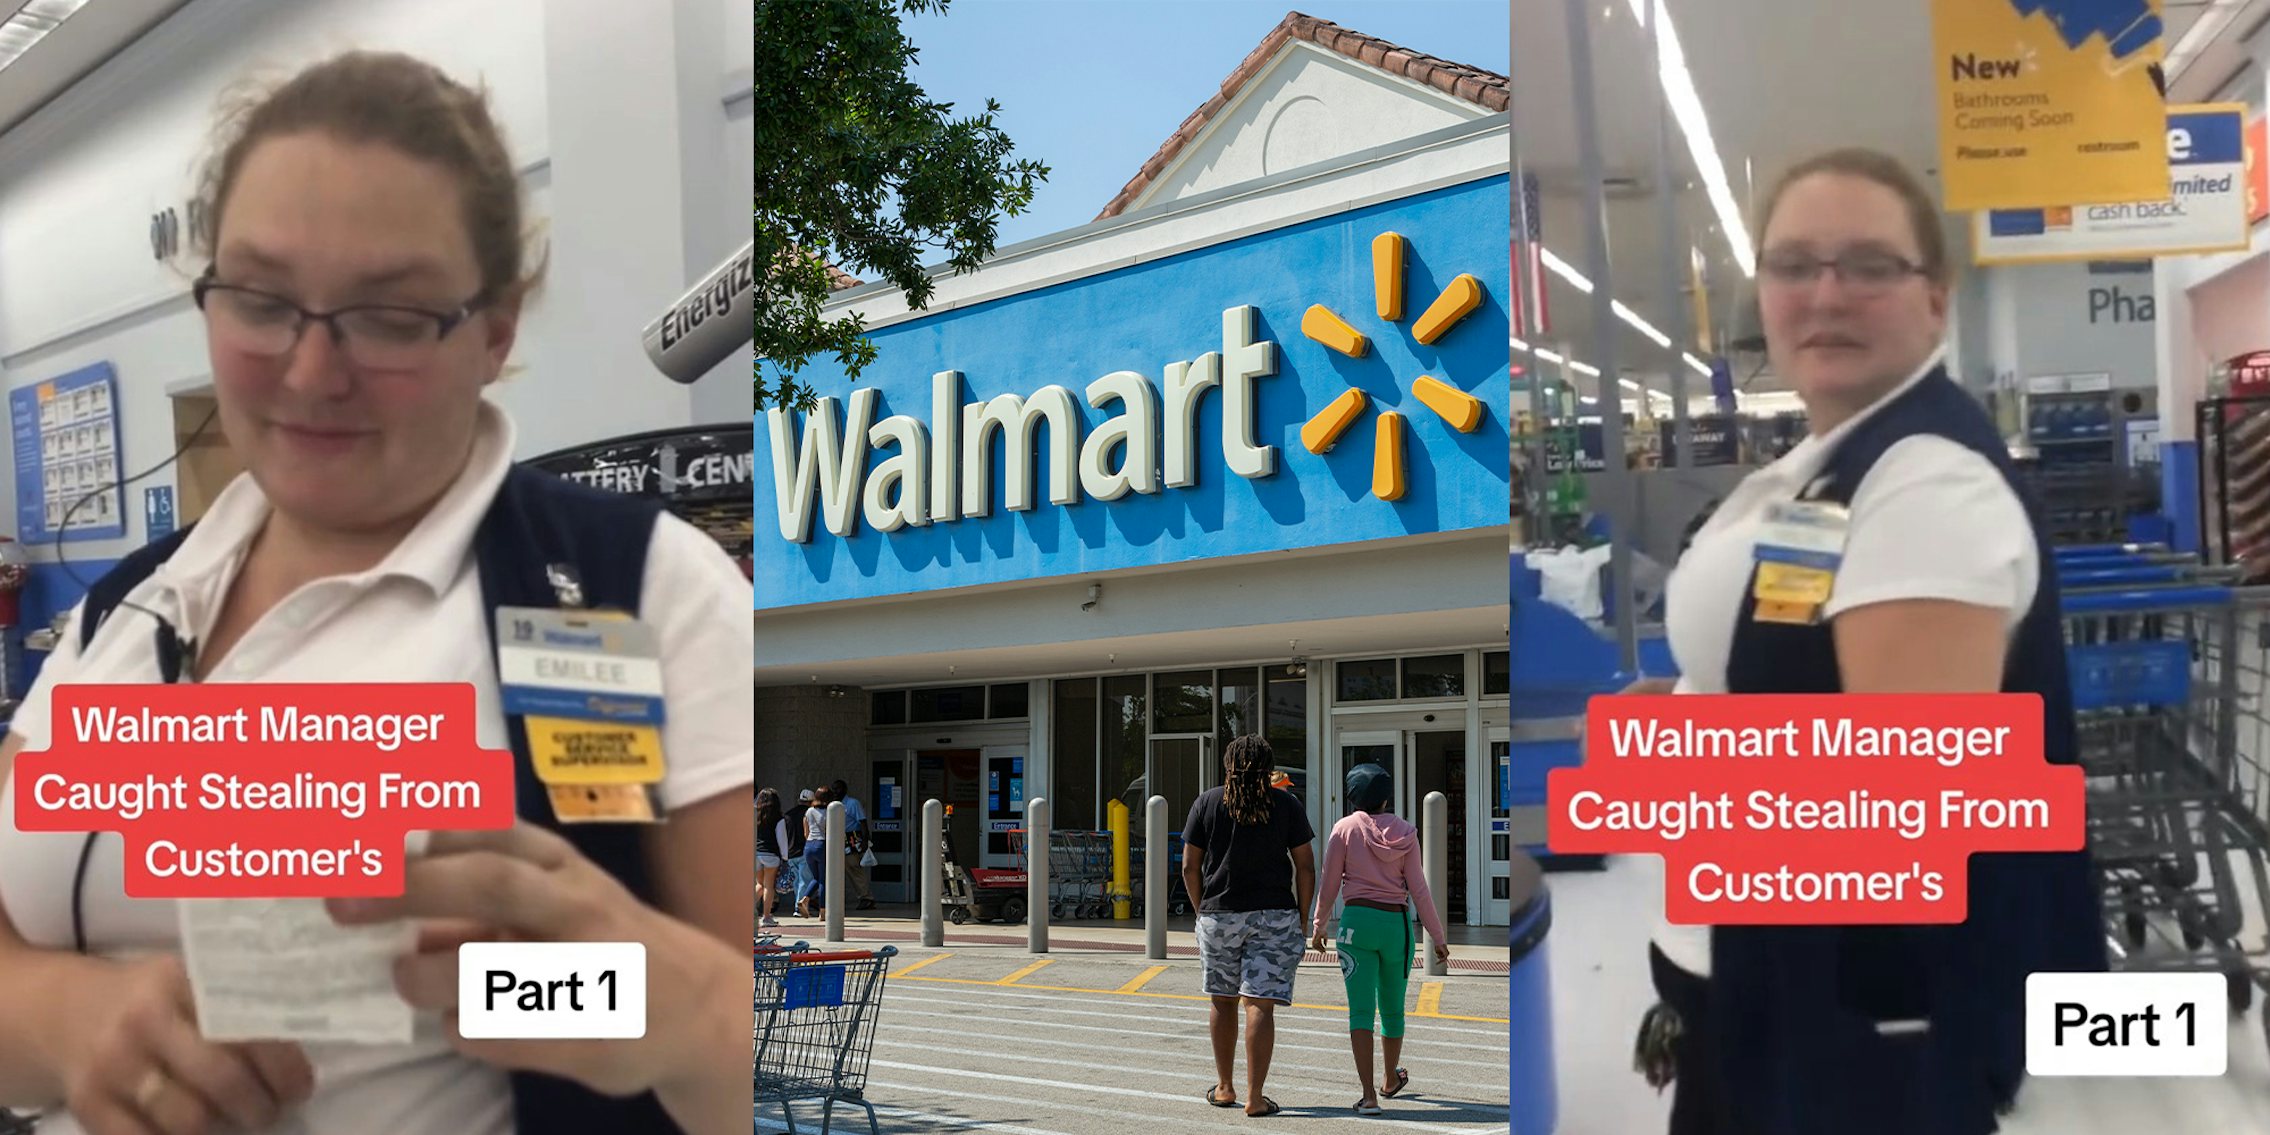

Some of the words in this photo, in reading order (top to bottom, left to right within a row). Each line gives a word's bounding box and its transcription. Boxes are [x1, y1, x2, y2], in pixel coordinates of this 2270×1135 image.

[1951, 52, 2021, 81] New
[1953, 91, 2050, 109] Bathrooms
[1955, 112, 2024, 133] Coming
[2029, 108, 2075, 127] Soon
[2077, 140, 2141, 154] restroom
[2170, 173, 2233, 195] mited
[767, 304, 1279, 544] Walmart
[535, 658, 627, 684] EMILEE
